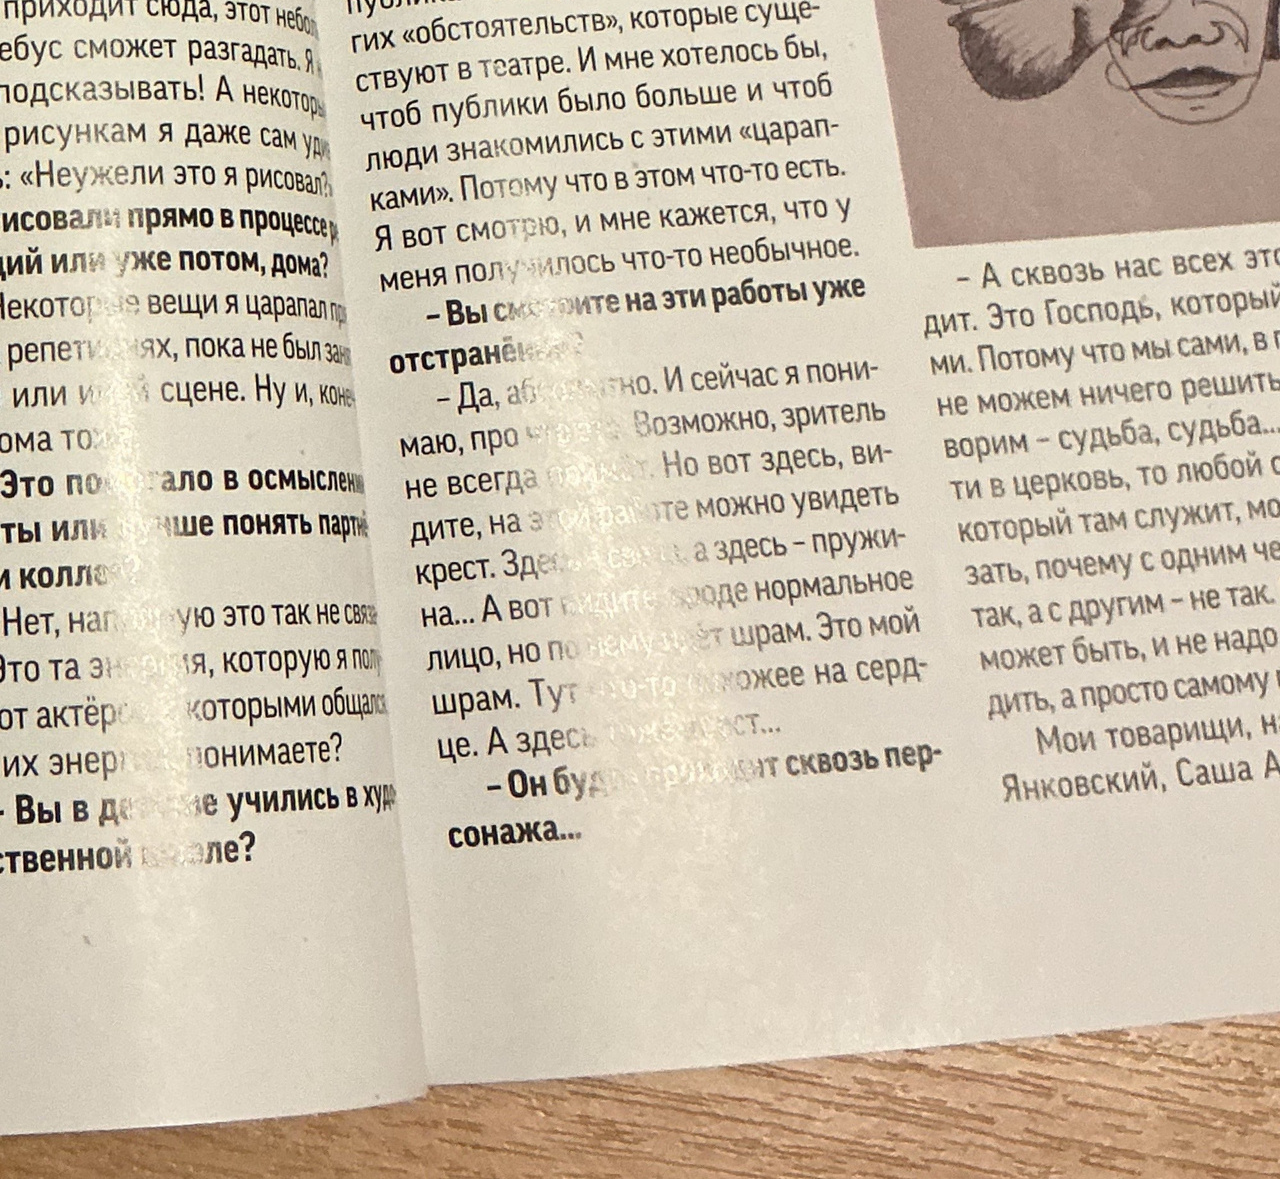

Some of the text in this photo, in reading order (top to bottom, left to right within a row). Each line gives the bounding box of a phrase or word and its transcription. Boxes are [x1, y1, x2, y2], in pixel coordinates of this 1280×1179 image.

[224, 0, 272, 25] этот
[4, 122, 147, 155] рисункам
[157, 122, 174, 143] я
[183, 122, 252, 149] даже
[259, 126, 298, 151] сам
[364, 117, 841, 173] люди знакомились с этими «царап-
[936, 379, 1173, 418] не можем ничего
[957, 501, 1242, 546] который там служит,
[963, 543, 1248, 587] зать, почему с одним
[1034, 716, 1253, 756] Мои товарищи,
[1001, 756, 1255, 804] Янковский, Саша
[447, 819, 583, 849] сонажа...
